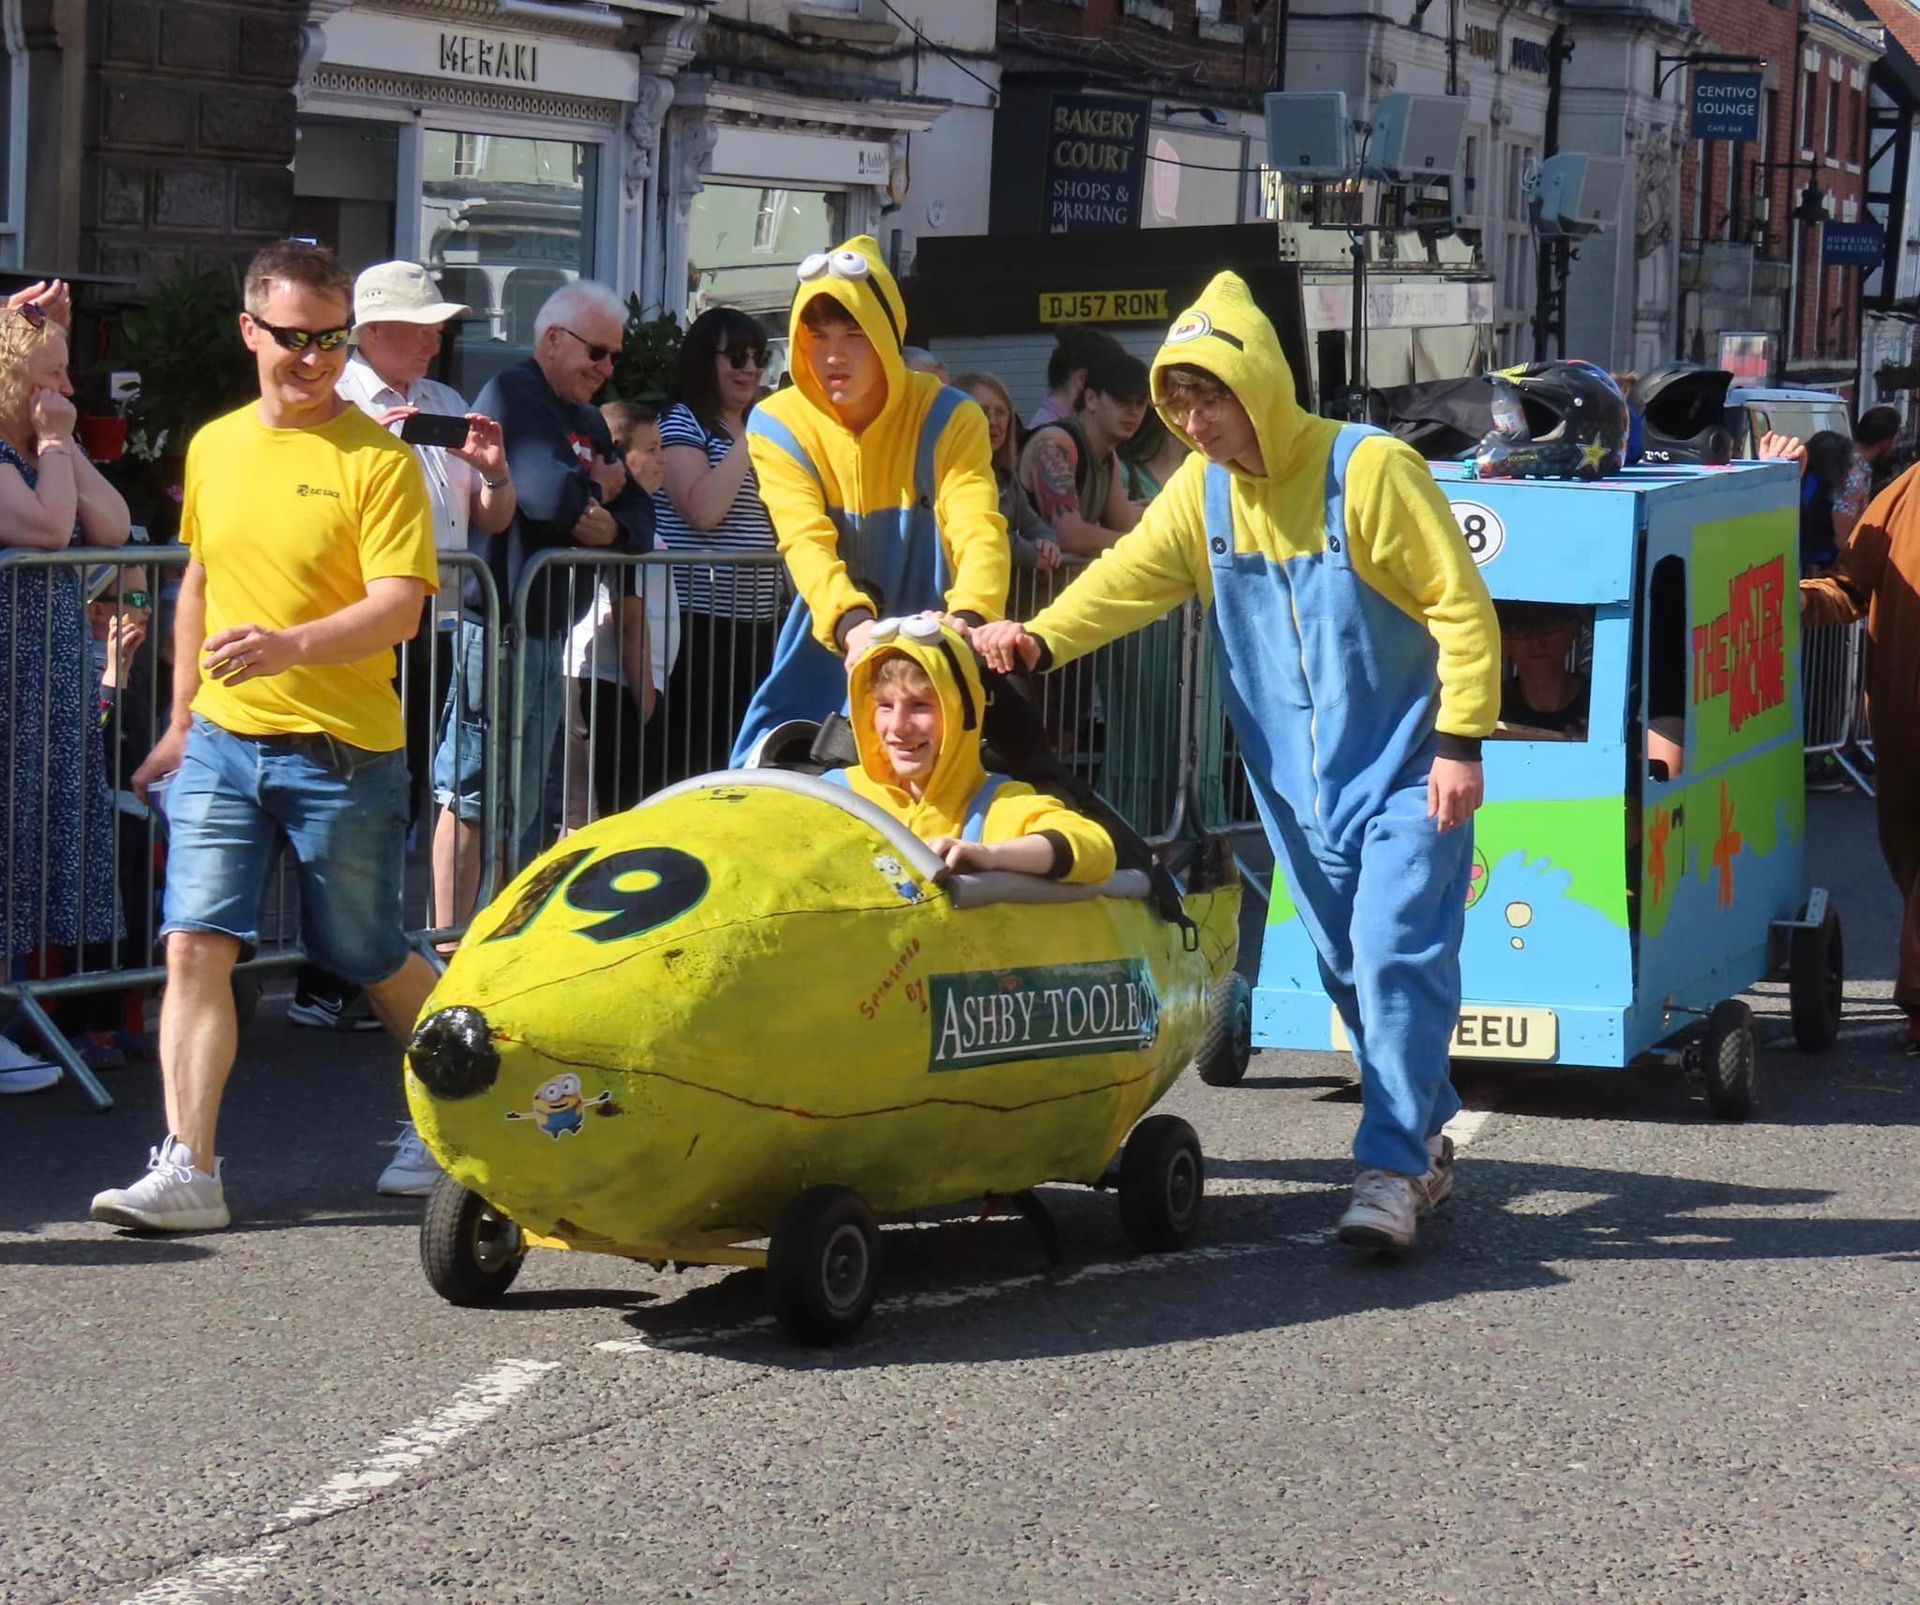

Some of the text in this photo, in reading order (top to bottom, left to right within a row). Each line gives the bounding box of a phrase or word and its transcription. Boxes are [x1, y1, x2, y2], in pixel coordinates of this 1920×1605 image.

[440, 33, 536, 82] MERAKI
[1697, 85, 1757, 99] CENTIVO
[1054, 106, 1140, 139] BAKERY
[1697, 103, 1755, 116] LOUNGE
[1054, 140, 1135, 173] COURT
[1053, 179, 1130, 202] SHOPS &
[1052, 200, 1129, 225] PARKING
[1049, 293, 1158, 318] DJ57 RON
[1693, 613, 1730, 705] THE
[480, 846, 711, 944] 19
[935, 987, 1035, 1060] ASHBY
